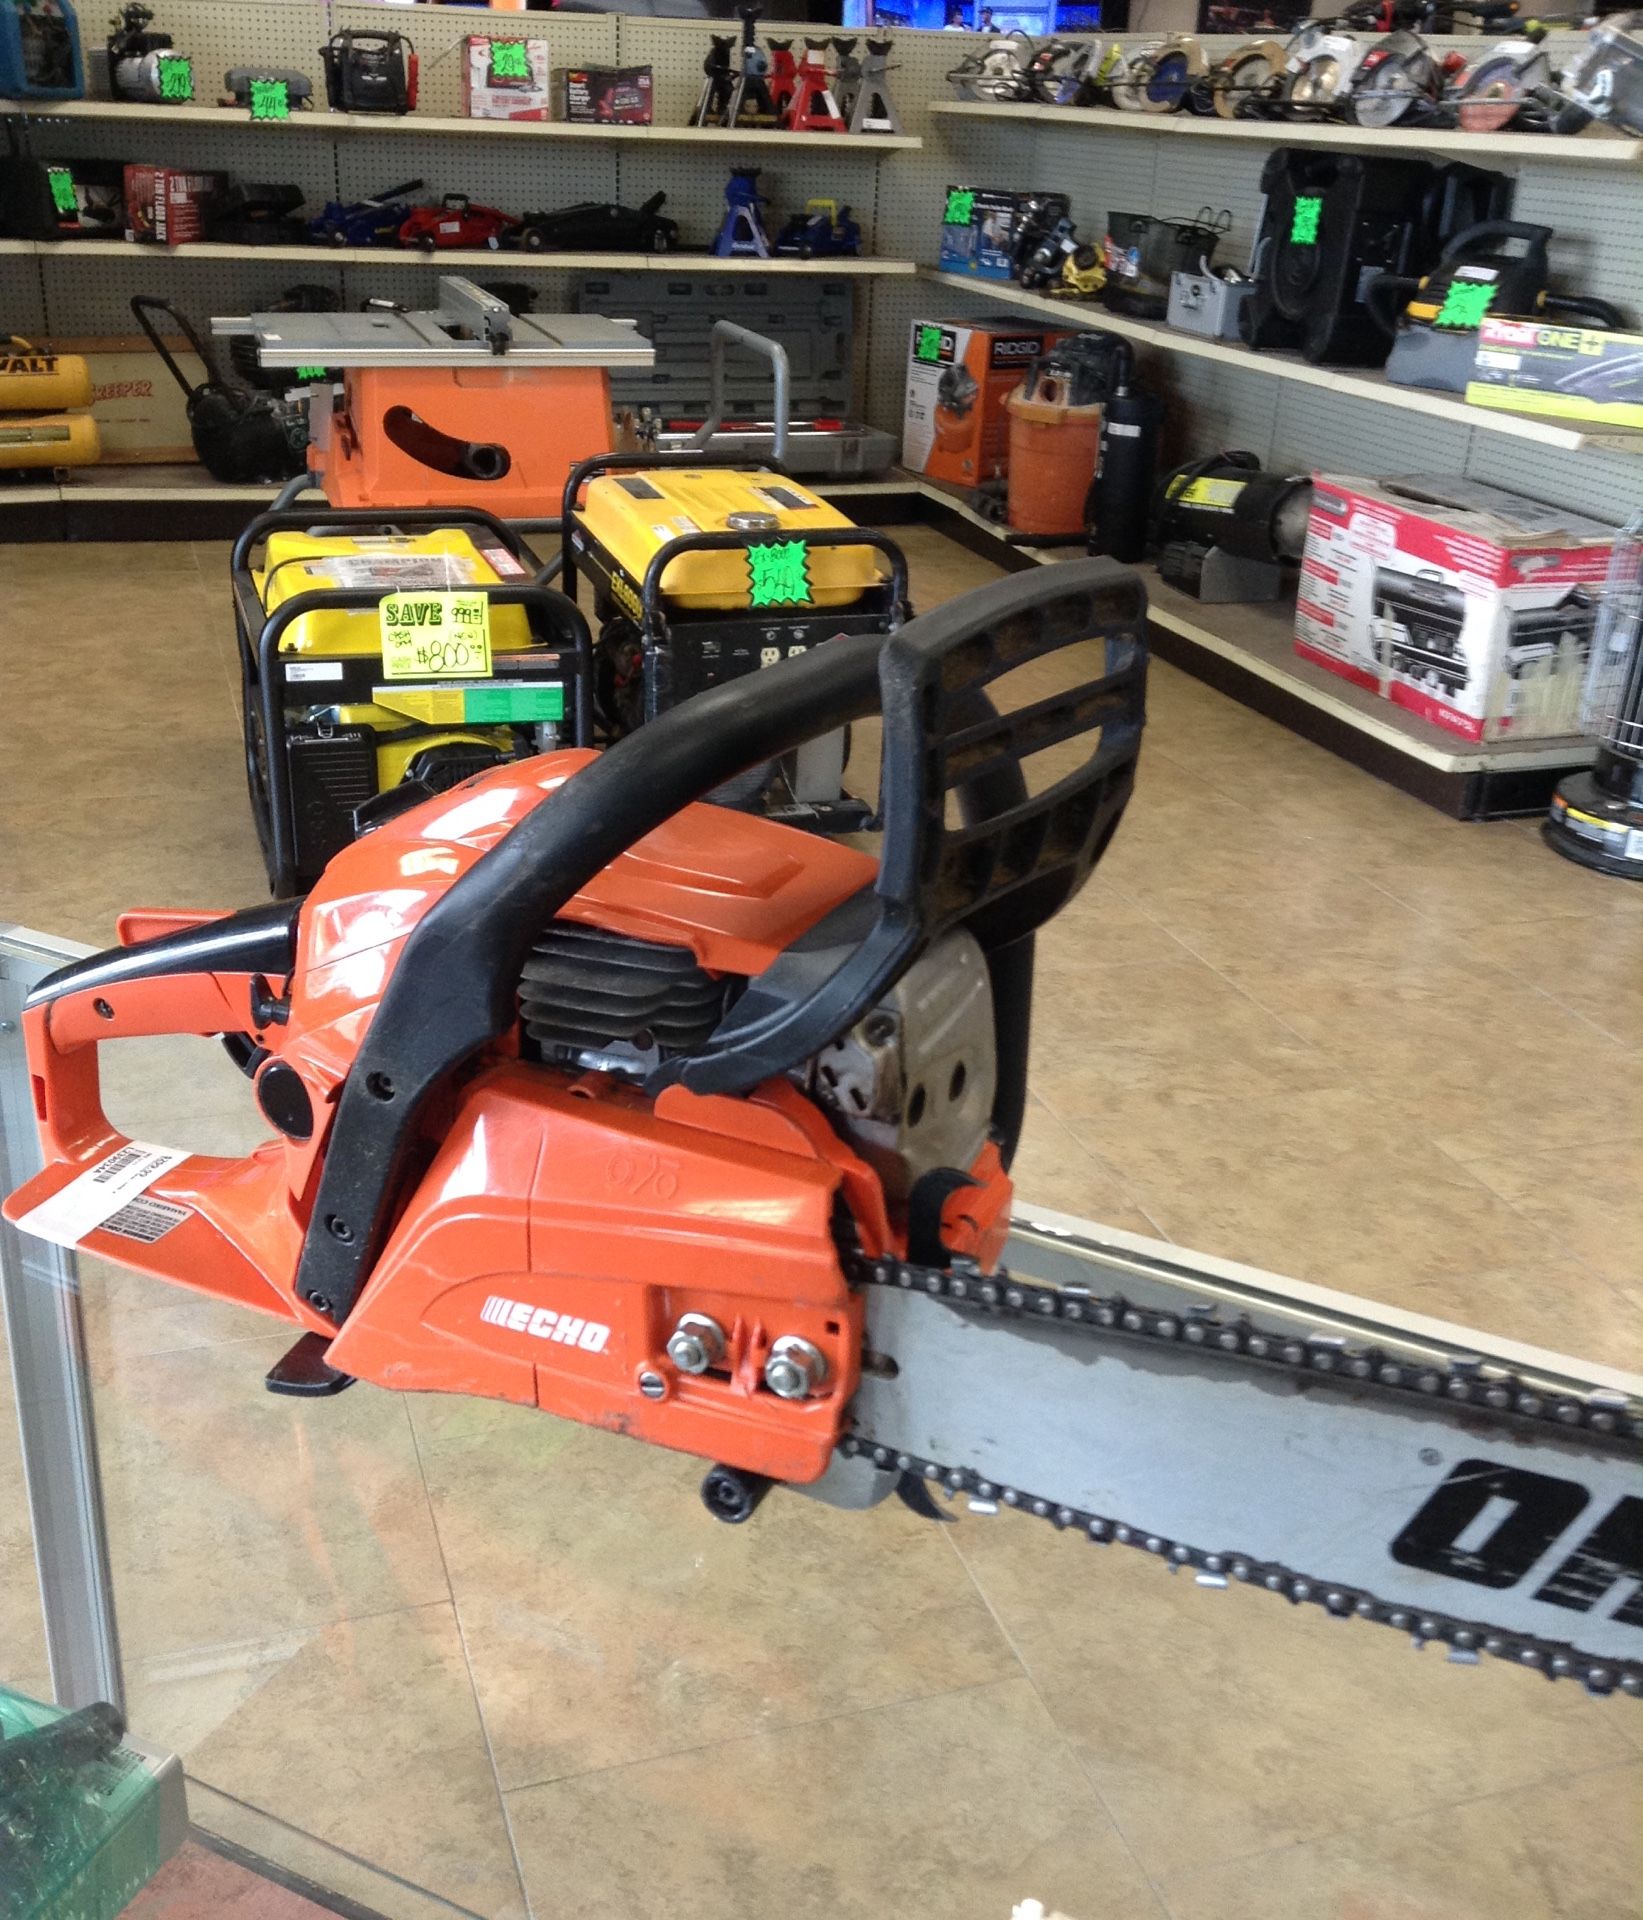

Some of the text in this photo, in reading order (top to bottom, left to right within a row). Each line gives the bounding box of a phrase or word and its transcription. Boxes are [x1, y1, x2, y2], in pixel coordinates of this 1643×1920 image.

[993, 341, 1040, 355] RIDGID
[386, 602, 443, 627] SAVE
[506, 1301, 611, 1354] ECHO
